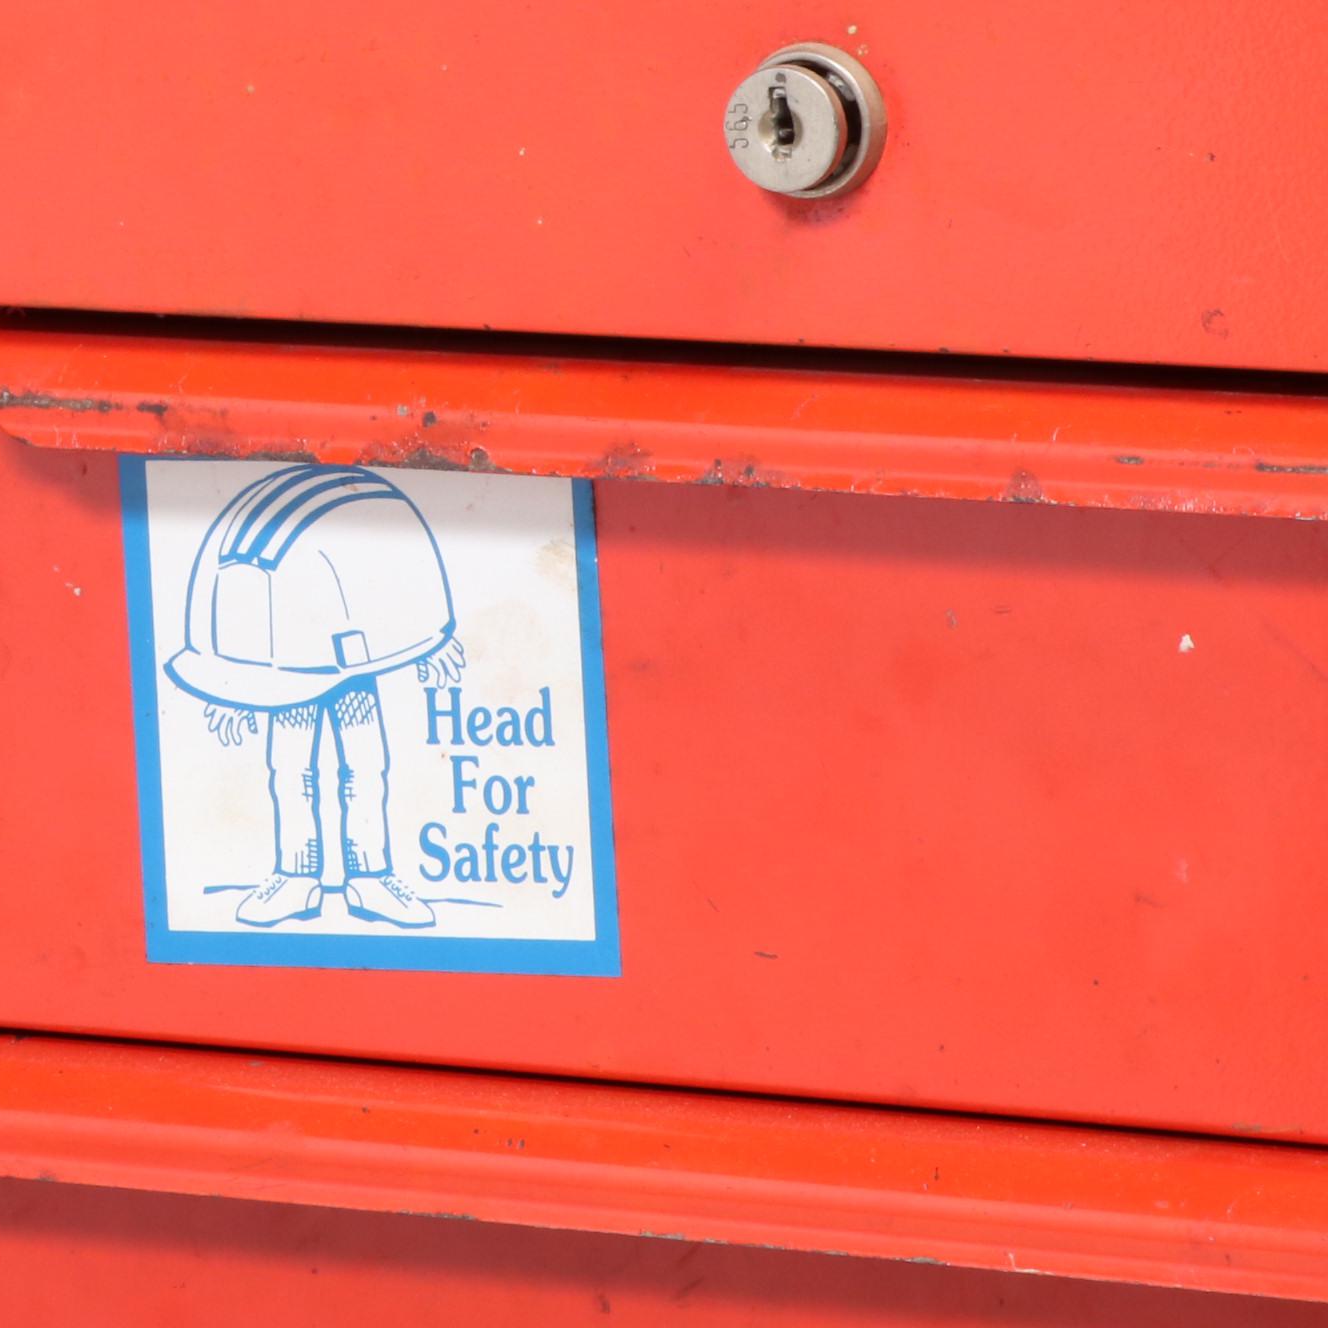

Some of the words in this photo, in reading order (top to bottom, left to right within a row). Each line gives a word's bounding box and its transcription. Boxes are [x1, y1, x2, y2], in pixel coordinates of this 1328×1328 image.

[725, 103, 751, 150] 565
[424, 686, 555, 747] Head
[449, 755, 536, 816] For
[418, 822, 574, 899] Safety
